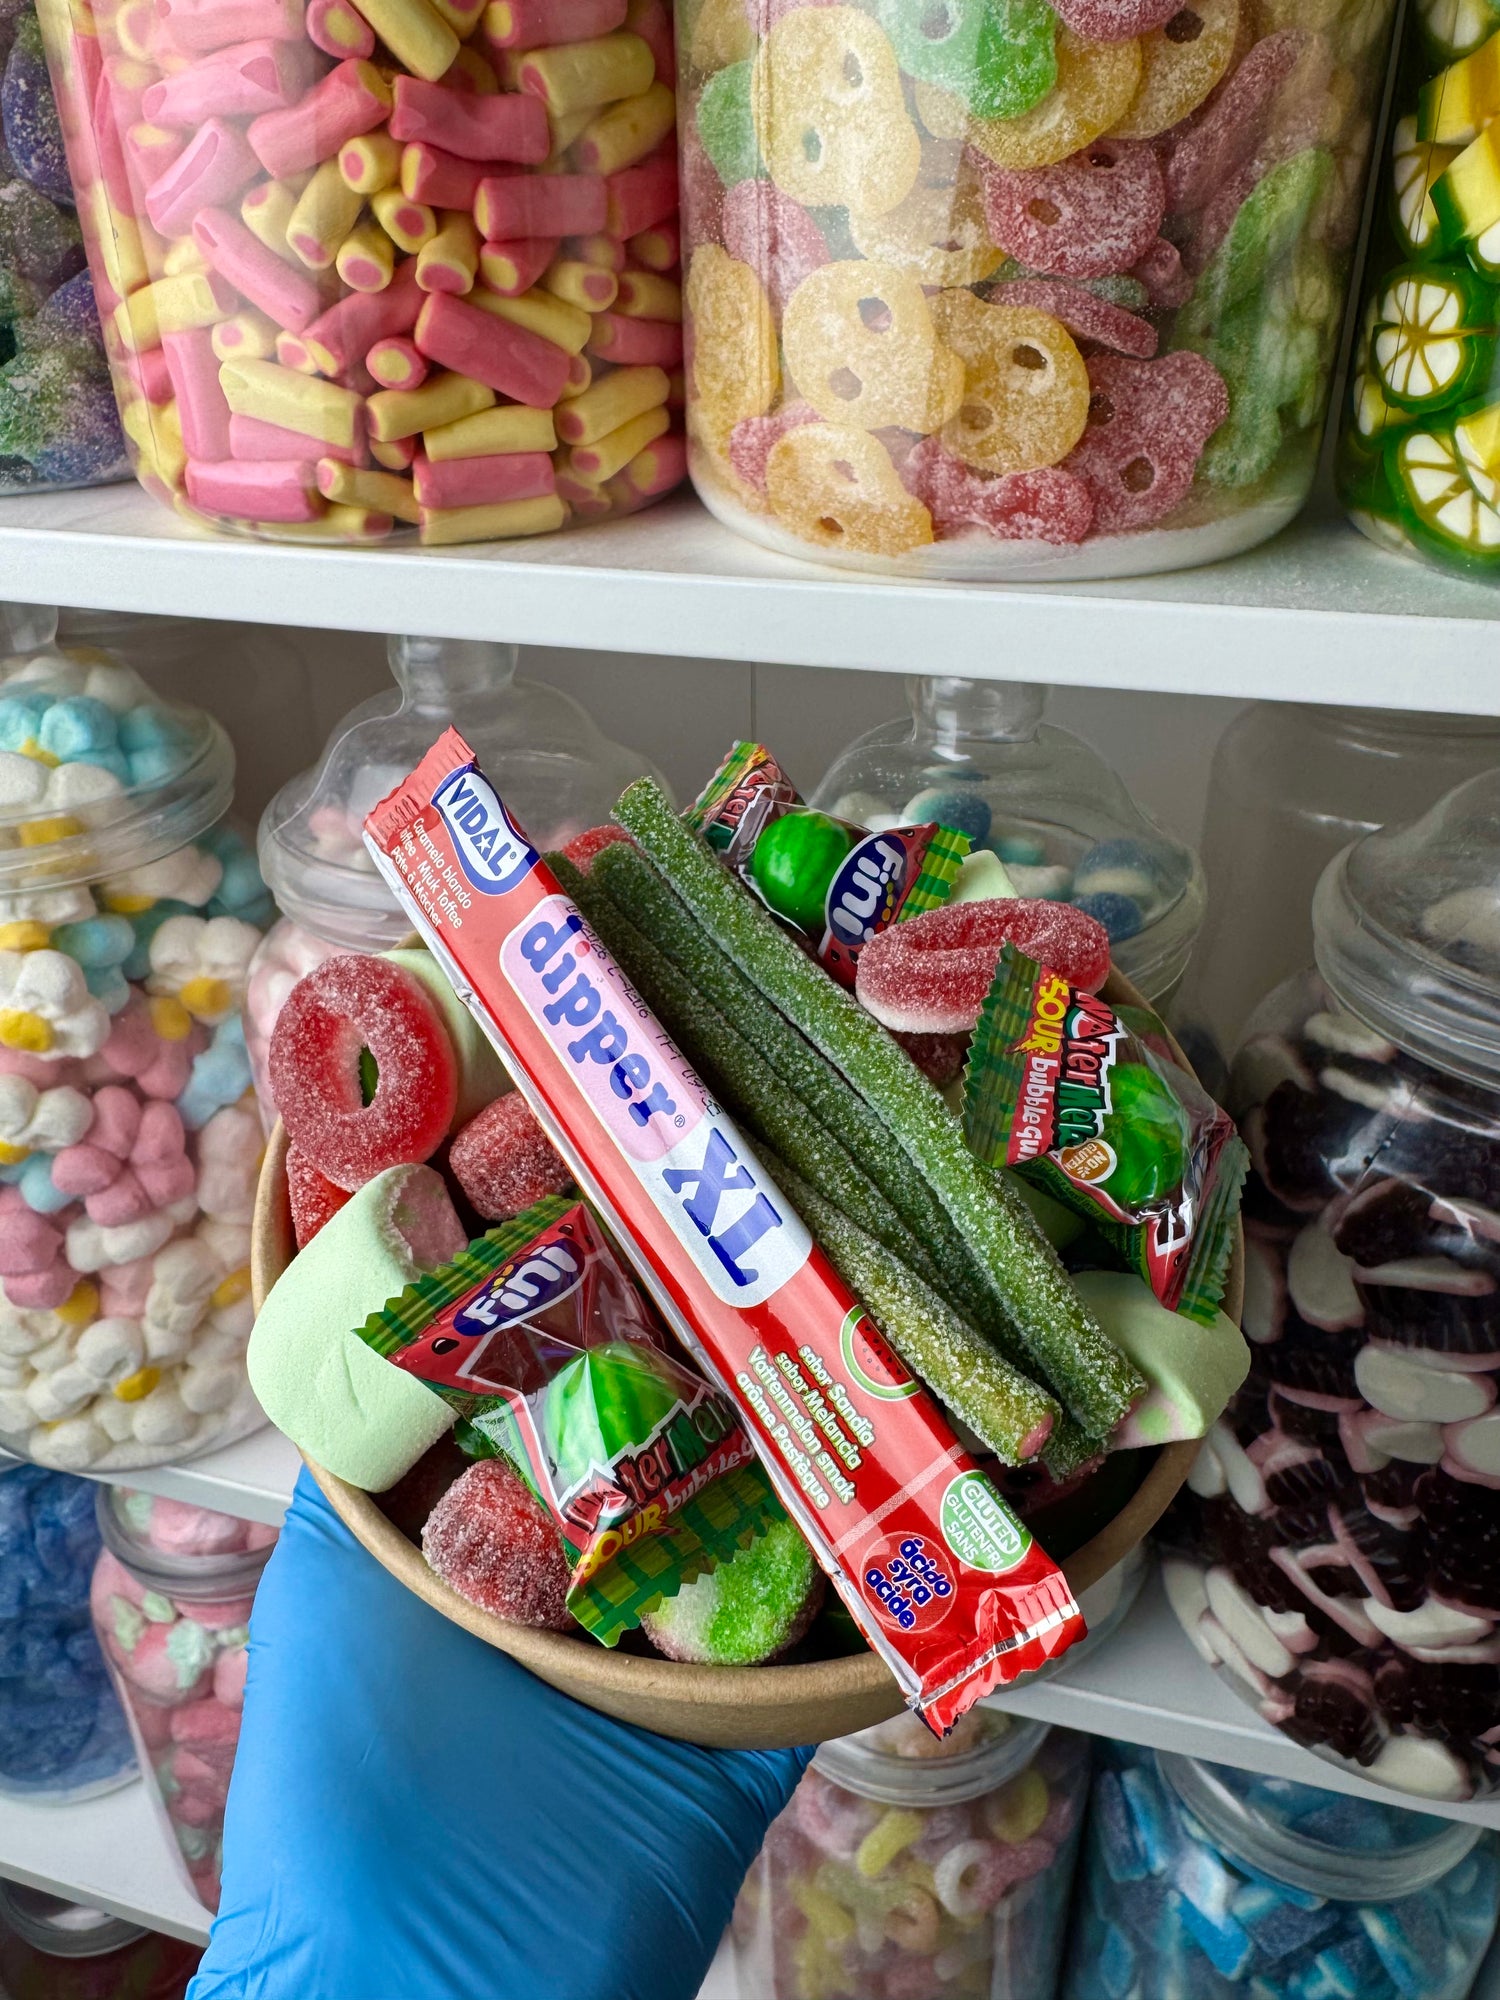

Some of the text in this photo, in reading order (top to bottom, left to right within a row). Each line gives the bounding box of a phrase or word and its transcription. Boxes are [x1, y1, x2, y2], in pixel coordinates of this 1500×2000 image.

[413, 817, 472, 909] Caramelo blando
[447, 777, 511, 877] VIDAL
[417, 860, 441, 893] Mjuk
[437, 889, 463, 929] Toffee
[831, 839, 904, 944] Fini
[520, 915, 677, 1128] dipper
[1022, 977, 1069, 1053] SOUR
[1087, 1151, 1108, 1169] NO
[661, 1127, 783, 1287] XL
[462, 1245, 579, 1326] Fini
[798, 1345, 833, 1387] sabor
[736, 1371, 830, 1509] arôme Pastèque
[748, 1345, 855, 1505] Vattenmelon smak
[774, 1352, 862, 1470] sabor Melancia
[946, 1494, 1003, 1568] GLUTENFRI
[946, 1521, 978, 1561] SANS
[965, 1484, 1019, 1552] GLUTEN
[866, 1569, 916, 1630] acide
[888, 1558, 932, 1607] syra
[899, 1537, 953, 1597] ácido
